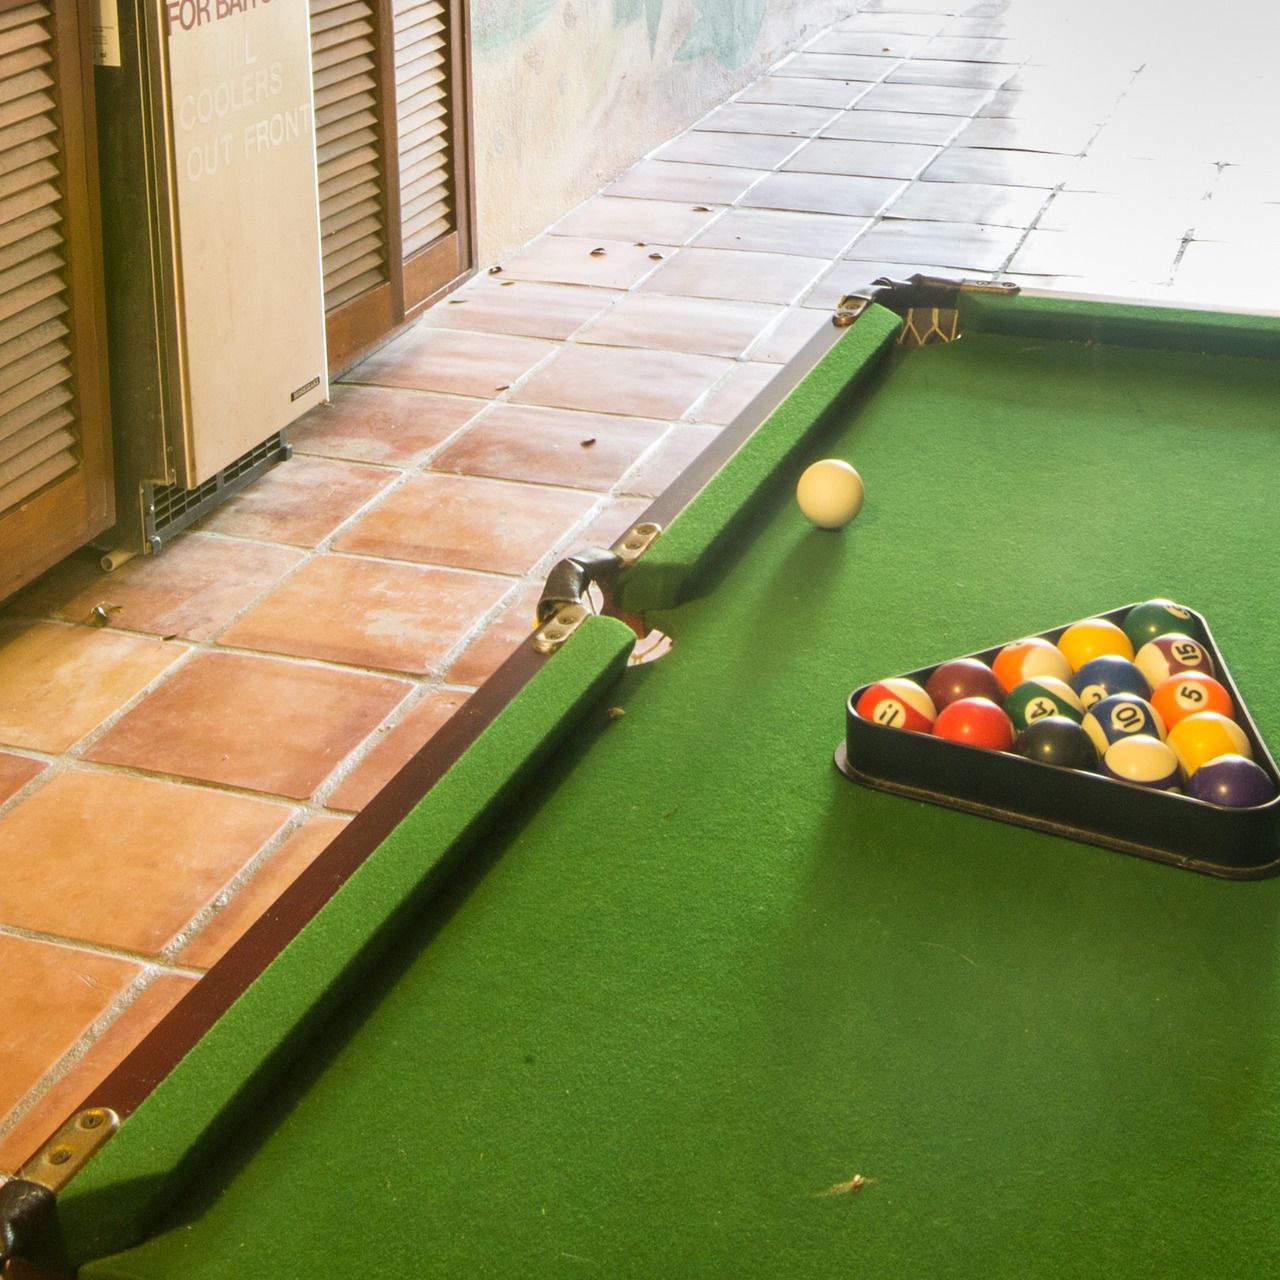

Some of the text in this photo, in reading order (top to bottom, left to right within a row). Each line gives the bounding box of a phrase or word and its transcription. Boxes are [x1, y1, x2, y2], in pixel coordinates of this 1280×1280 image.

[179, 61, 282, 131] COOLERS
[186, 103, 311, 183] OUT FRONT
[1174, 643, 1200, 661] 15
[1180, 686, 1203, 702] 5
[1116, 706, 1141, 729] 10
